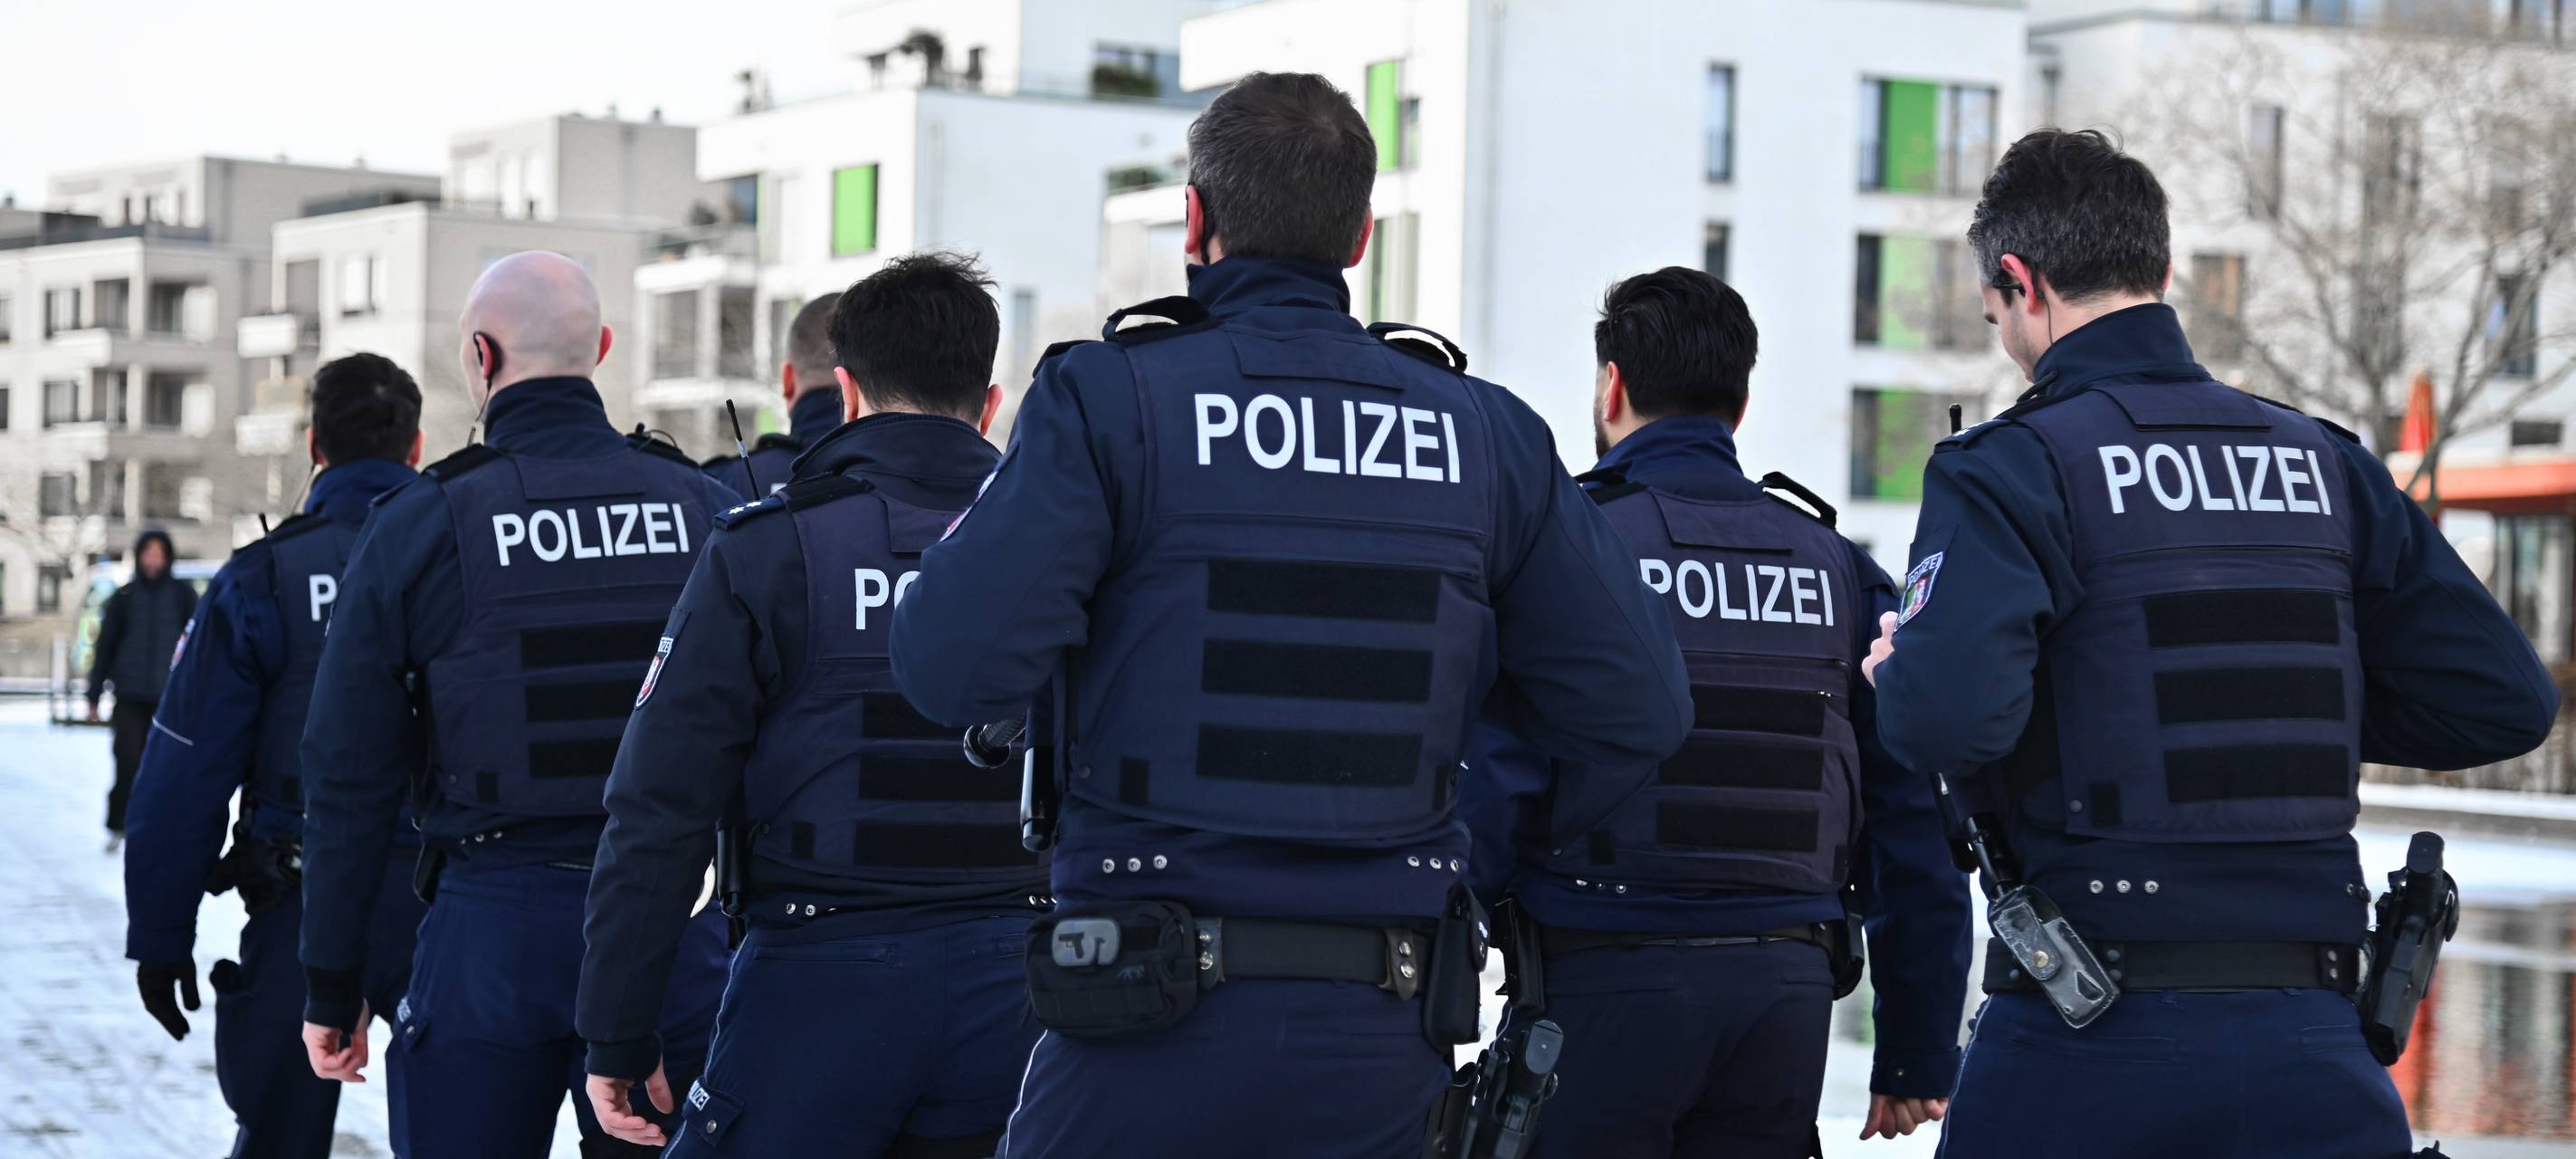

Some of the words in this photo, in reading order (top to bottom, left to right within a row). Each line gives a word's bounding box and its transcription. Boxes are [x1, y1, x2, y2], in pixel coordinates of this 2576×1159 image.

[1194, 393, 1461, 484] POLIZEI
[2097, 443, 2332, 516] POLIZEI
[491, 503, 690, 567] POLIZEI
[1639, 558, 1834, 627] POLIZEI
